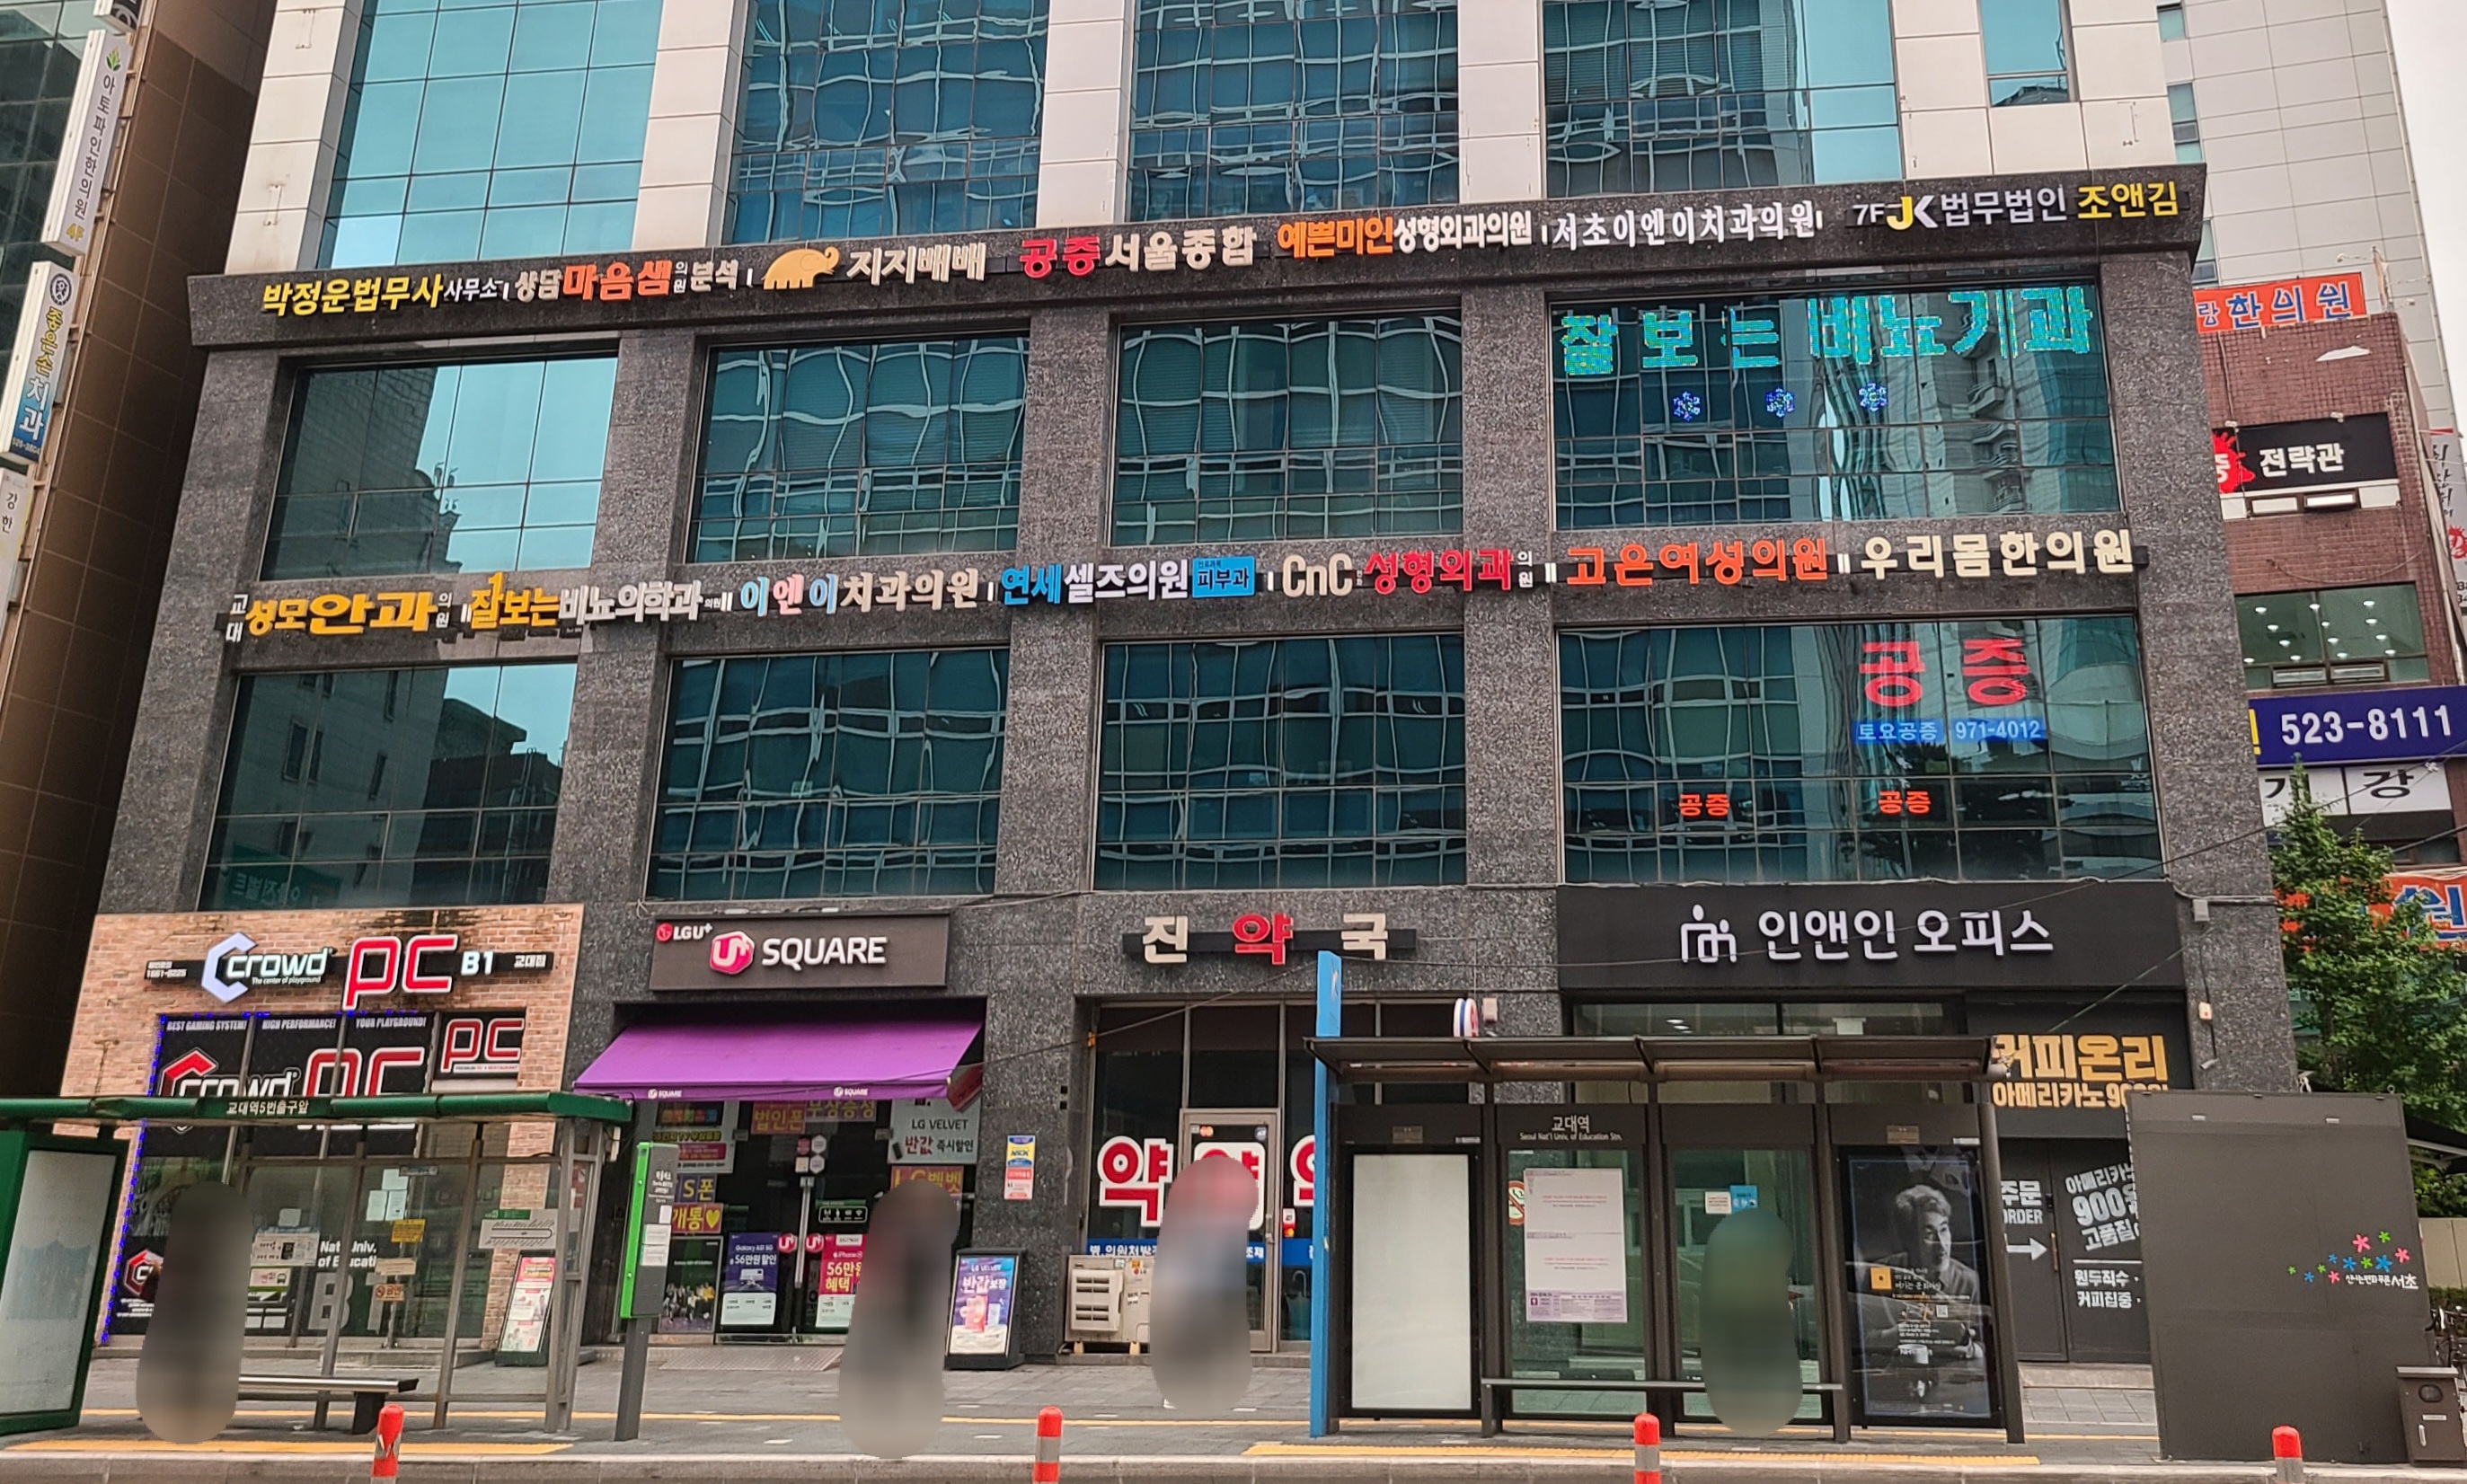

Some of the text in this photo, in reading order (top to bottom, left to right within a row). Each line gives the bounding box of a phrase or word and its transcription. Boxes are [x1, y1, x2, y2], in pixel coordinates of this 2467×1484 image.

[1852, 203, 1885, 226] 7F
[1940, 186, 2067, 228] 법무법인
[2077, 181, 2180, 219] 조앤김
[847, 242, 986, 286] 지지배배
[1019, 225, 1257, 280] 공증 서울종합
[690, 259, 739, 292] 분석
[261, 273, 446, 317] 박정운법무사
[2227, 281, 2352, 329] 한의원
[1806, 286, 2093, 366] 비뇨기과
[19, 375, 50, 441] 치과
[2259, 442, 2346, 478] 전략관
[1566, 536, 1829, 587] 고은여성의원
[1861, 527, 2135, 579] 우리몸한의원
[1000, 559, 1189, 606] 연세셀즈의원
[1197, 567, 1250, 590] 피부과
[1282, 548, 1534, 597] CnC 성형외과 의원
[225, 593, 249, 642] 교대
[245, 590, 452, 636] 성모안과 의원
[558, 579, 704, 623] 비뇨의학과
[1860, 638, 2031, 708] 공증
[1857, 720, 2042, 742] 토요공증 971-4012
[2281, 704, 2452, 746] 523-8111
[1678, 793, 1730, 817] 공증
[1878, 790, 1932, 815] 공증
[673, 923, 713, 941] LGU+
[1757, 908, 2055, 961] 인앤인 오피스
[460, 950, 494, 976] B1
[761, 936, 889, 971] SQUARE
[166, 1019, 247, 1031] BEST GAMING SYSTEM!
[261, 1018, 337, 1030] HIGH PERFORMANCE!
[356, 1016, 427, 1029] YOUR PLAYGROUND!
[1989, 1034, 2169, 1082] 커피온리
[912, 1118, 968, 1130] LG VELVET
[1552, 1115, 1590, 1134] 교대역
[905, 1135, 974, 1155] 반값 즉시할인
[1100, 1138, 1172, 1224] 약
[2002, 1180, 2042, 1206] 주문
[318, 1256, 330, 1268] of
[735, 1254, 761, 1265] 56만원
[826, 1276, 850, 1292] 혜택
[2391, 1273, 2419, 1290] 서초
